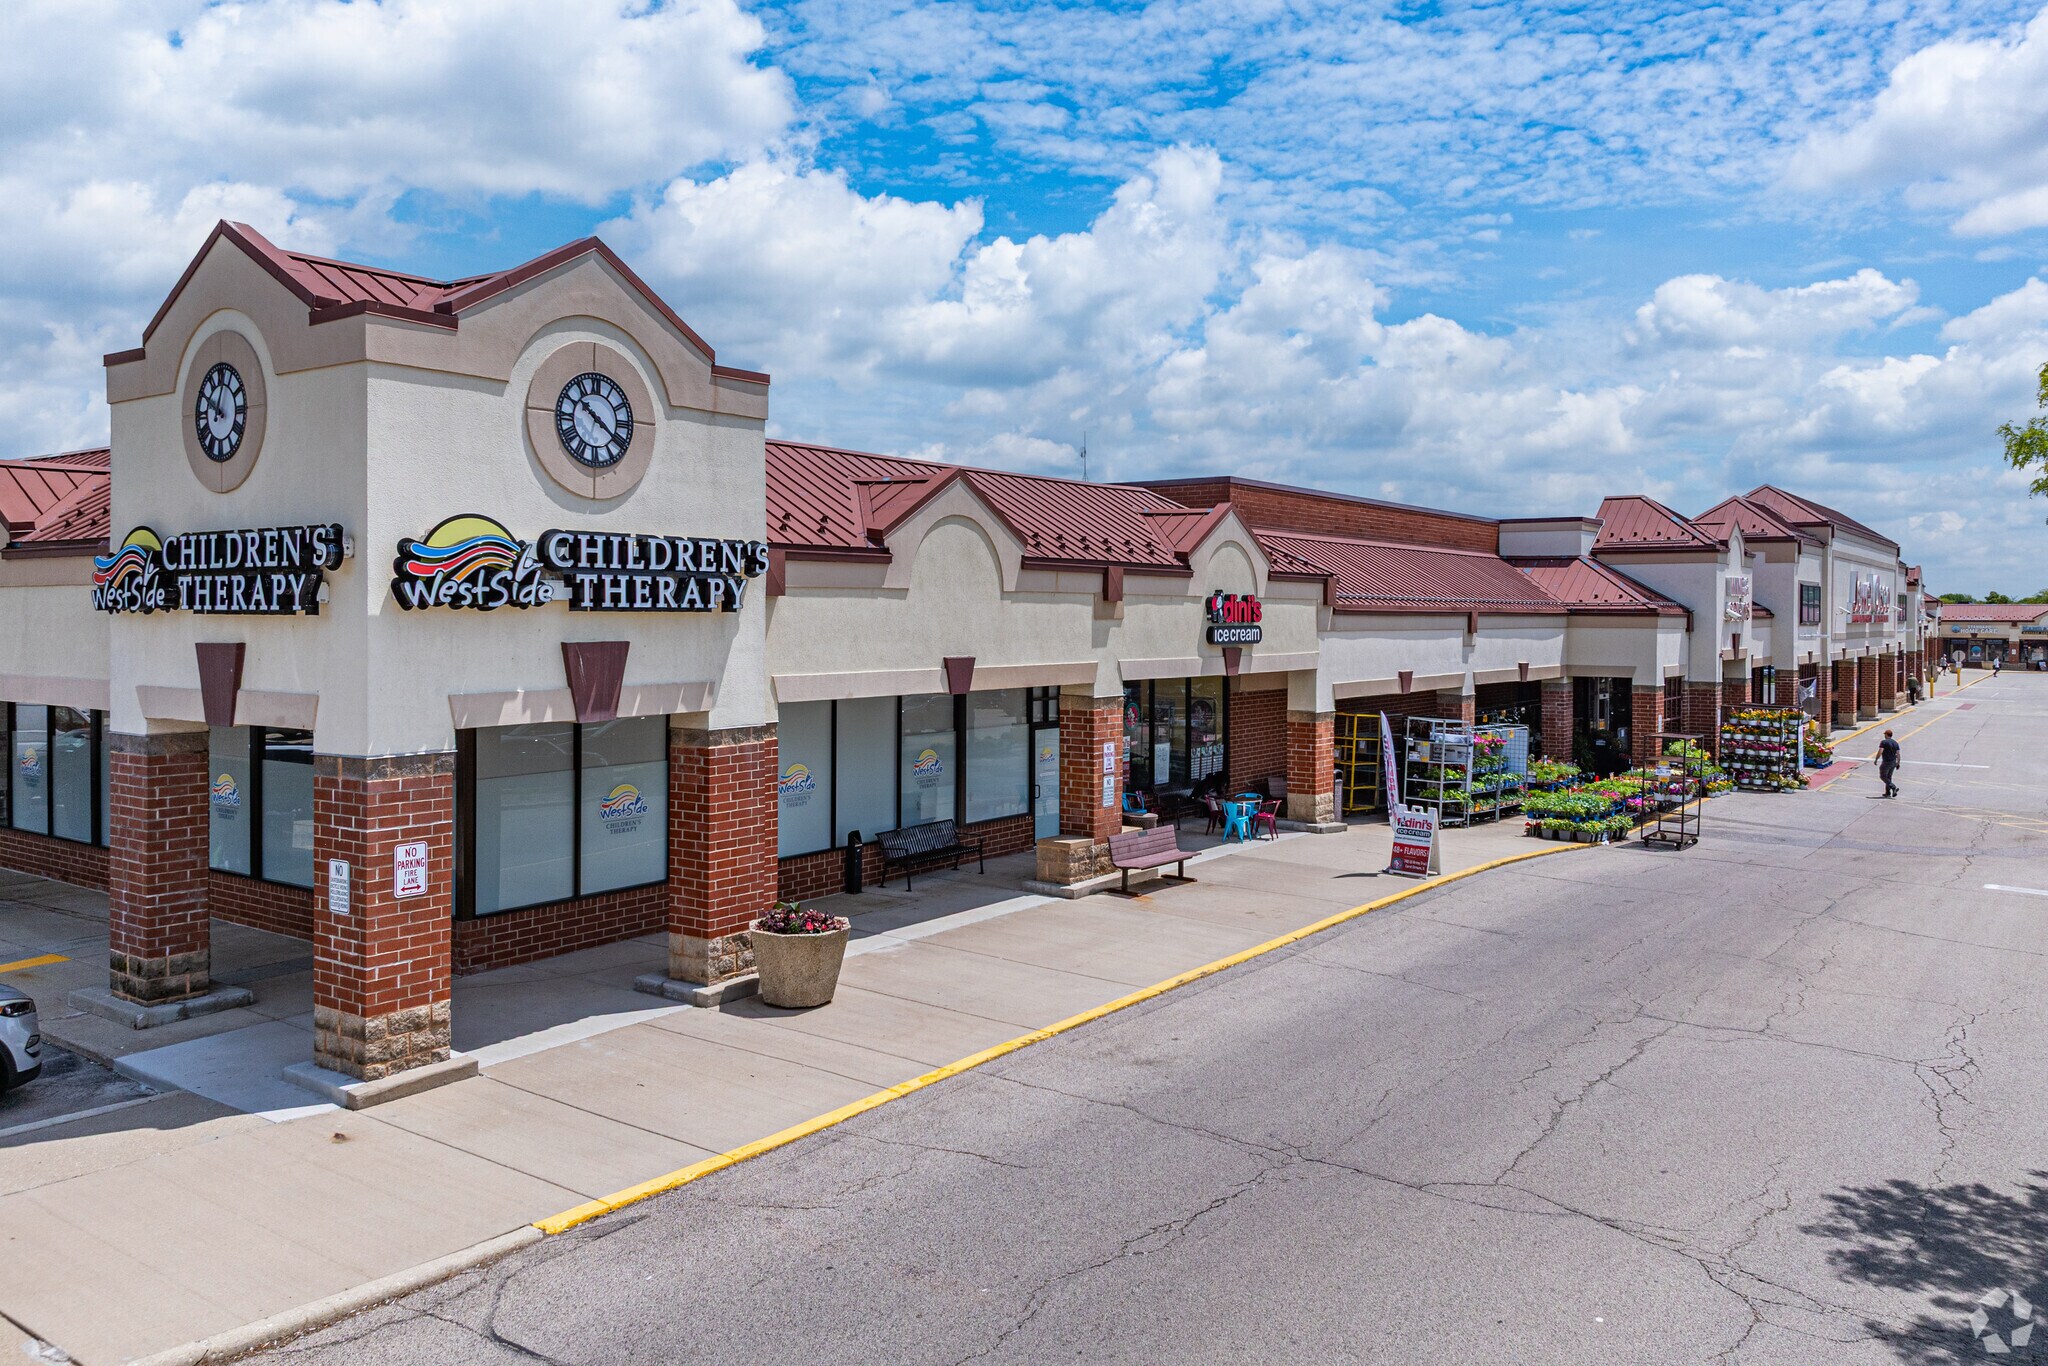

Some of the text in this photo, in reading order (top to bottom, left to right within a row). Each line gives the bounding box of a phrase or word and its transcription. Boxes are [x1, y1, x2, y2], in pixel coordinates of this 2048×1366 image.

[162, 527, 328, 572] CHILDREN'S
[549, 532, 770, 573] CHILDREN'S
[91, 573, 166, 611] WestSide
[178, 573, 306, 611] THERAPY
[404, 569, 555, 608] WestSide
[576, 573, 748, 610] THERAPY
[1214, 626, 1260, 642] ice cream
[397, 857, 425, 871] PARKING
[405, 847, 417, 858] NO
[335, 864, 344, 877] NO
[403, 876, 419, 886] LANE
[404, 869, 418, 878] FIRE
